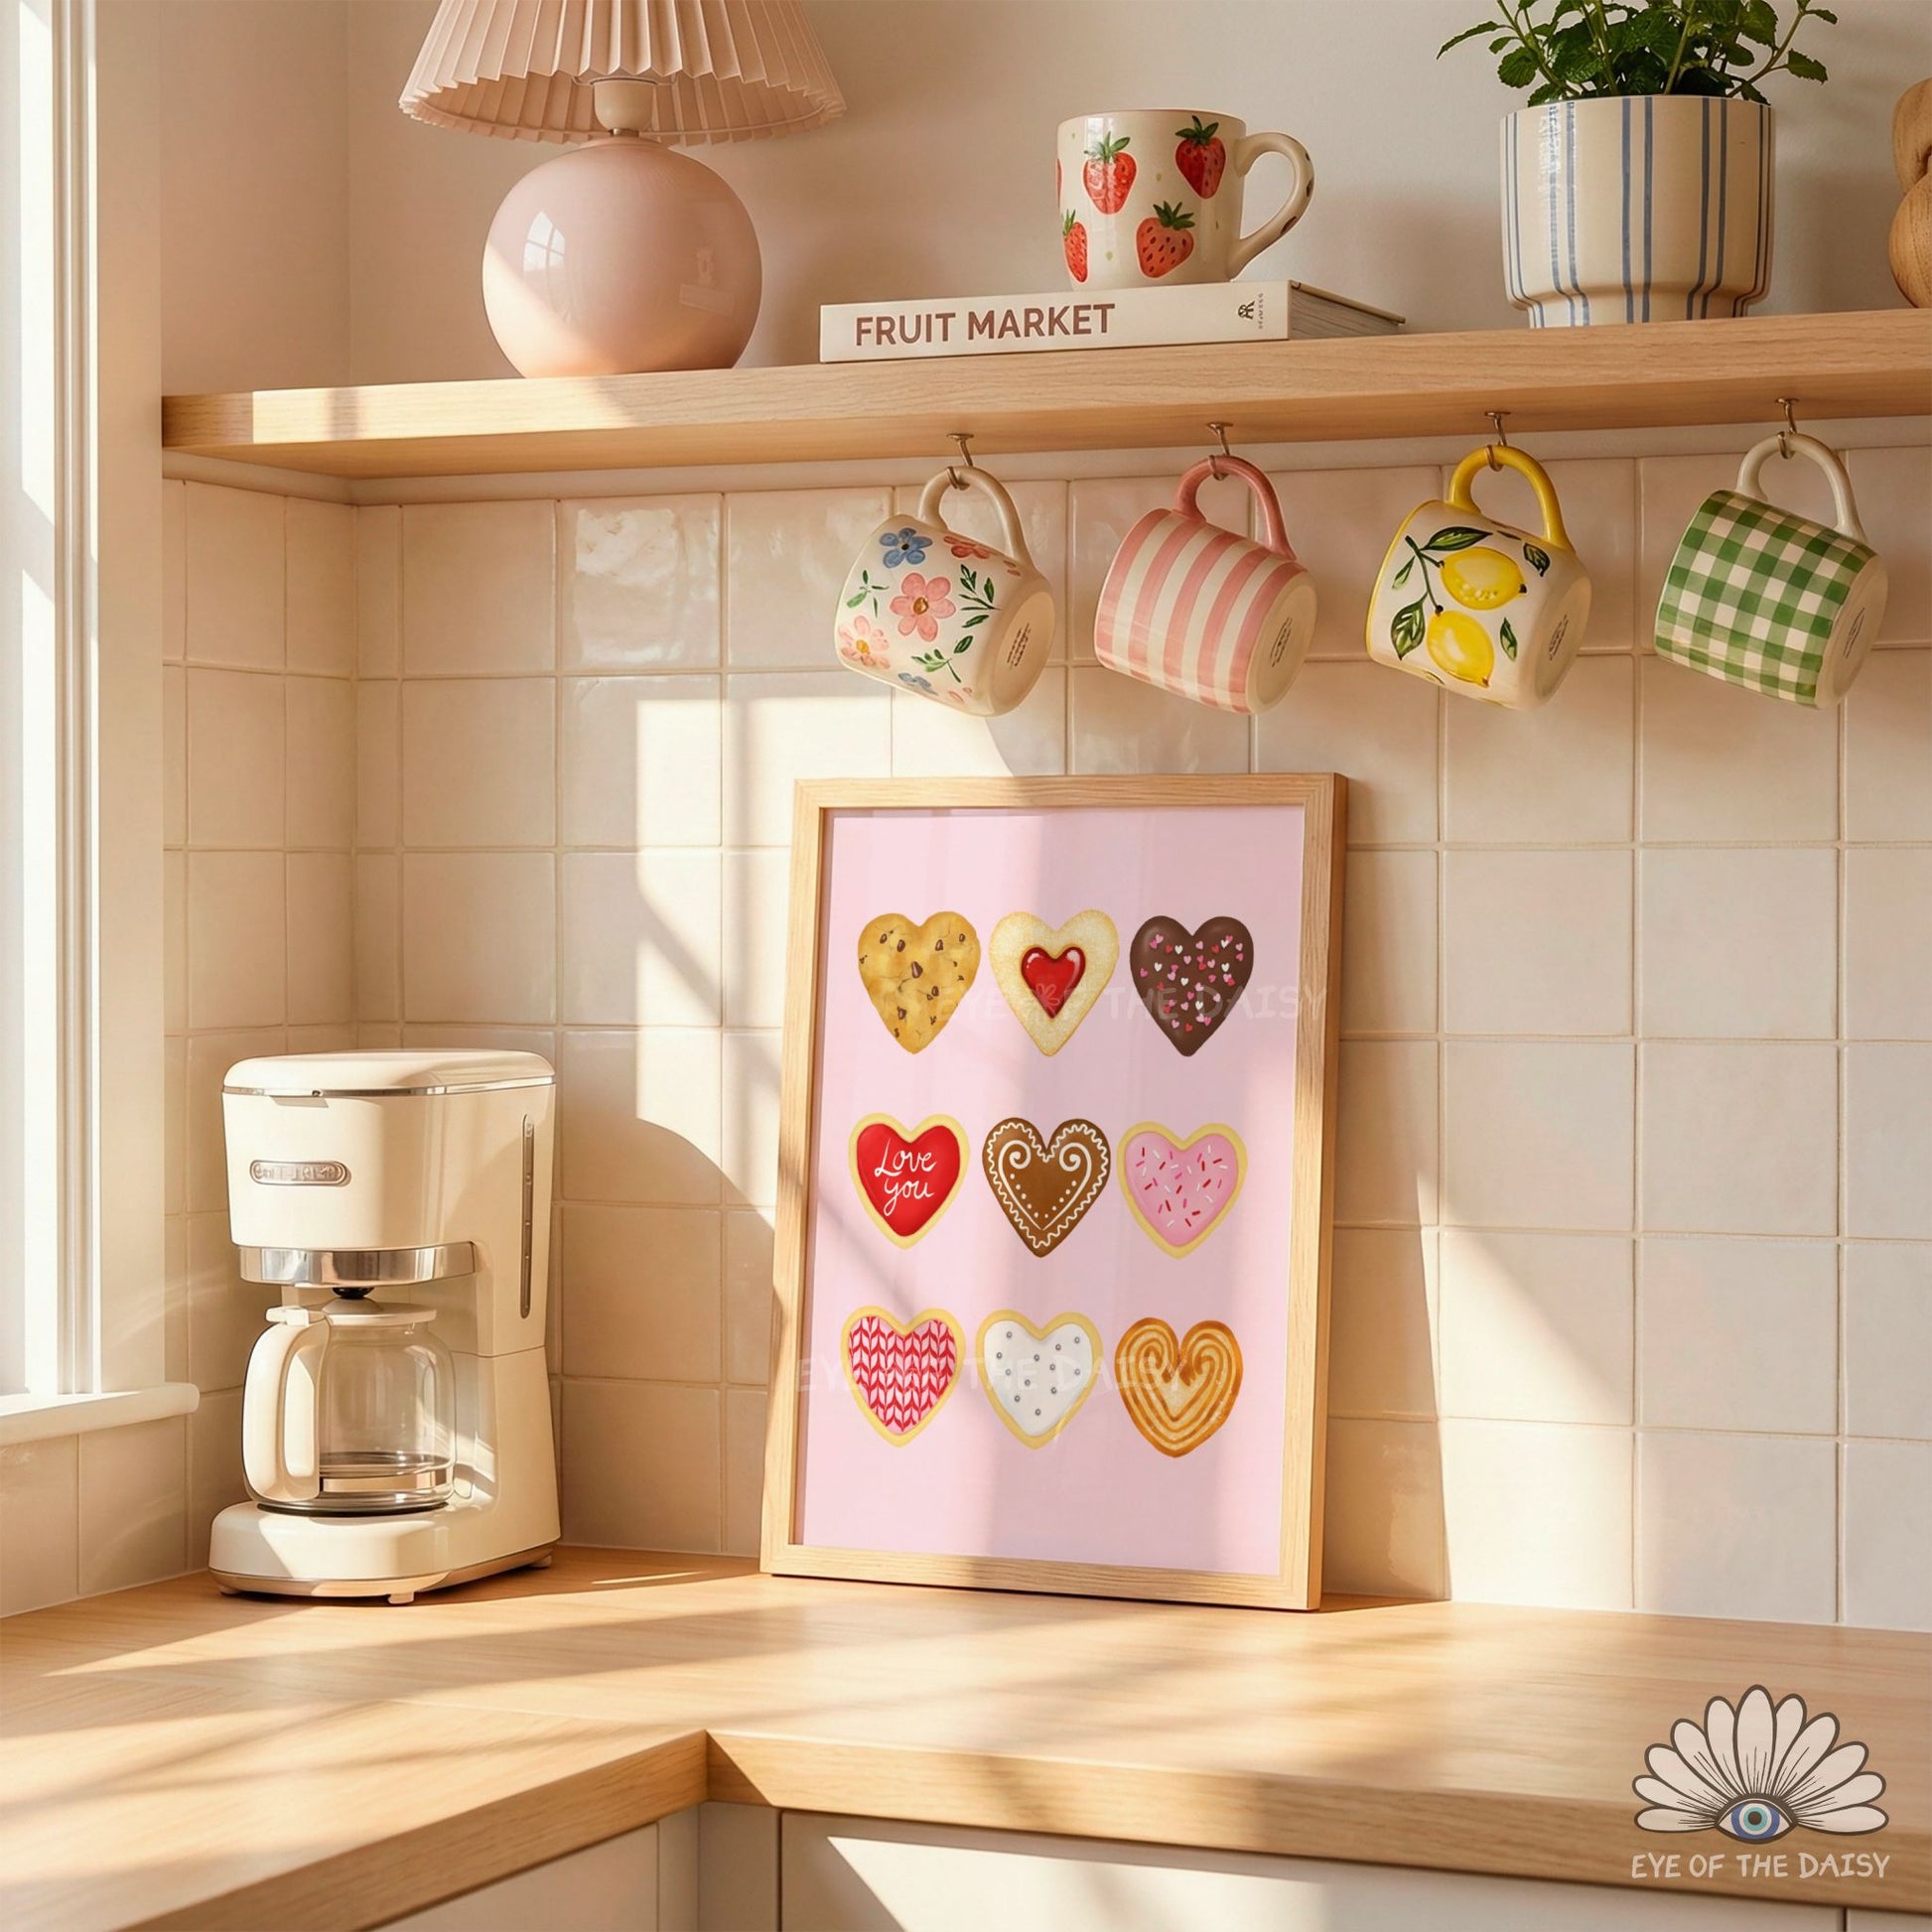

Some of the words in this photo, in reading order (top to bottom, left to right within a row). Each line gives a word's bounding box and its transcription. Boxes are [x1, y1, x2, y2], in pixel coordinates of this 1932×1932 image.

[855, 312, 957, 346] FRUIT
[967, 303, 1116, 341] MARKET
[874, 1137, 938, 1177] Love
[883, 1177, 936, 1217] you
